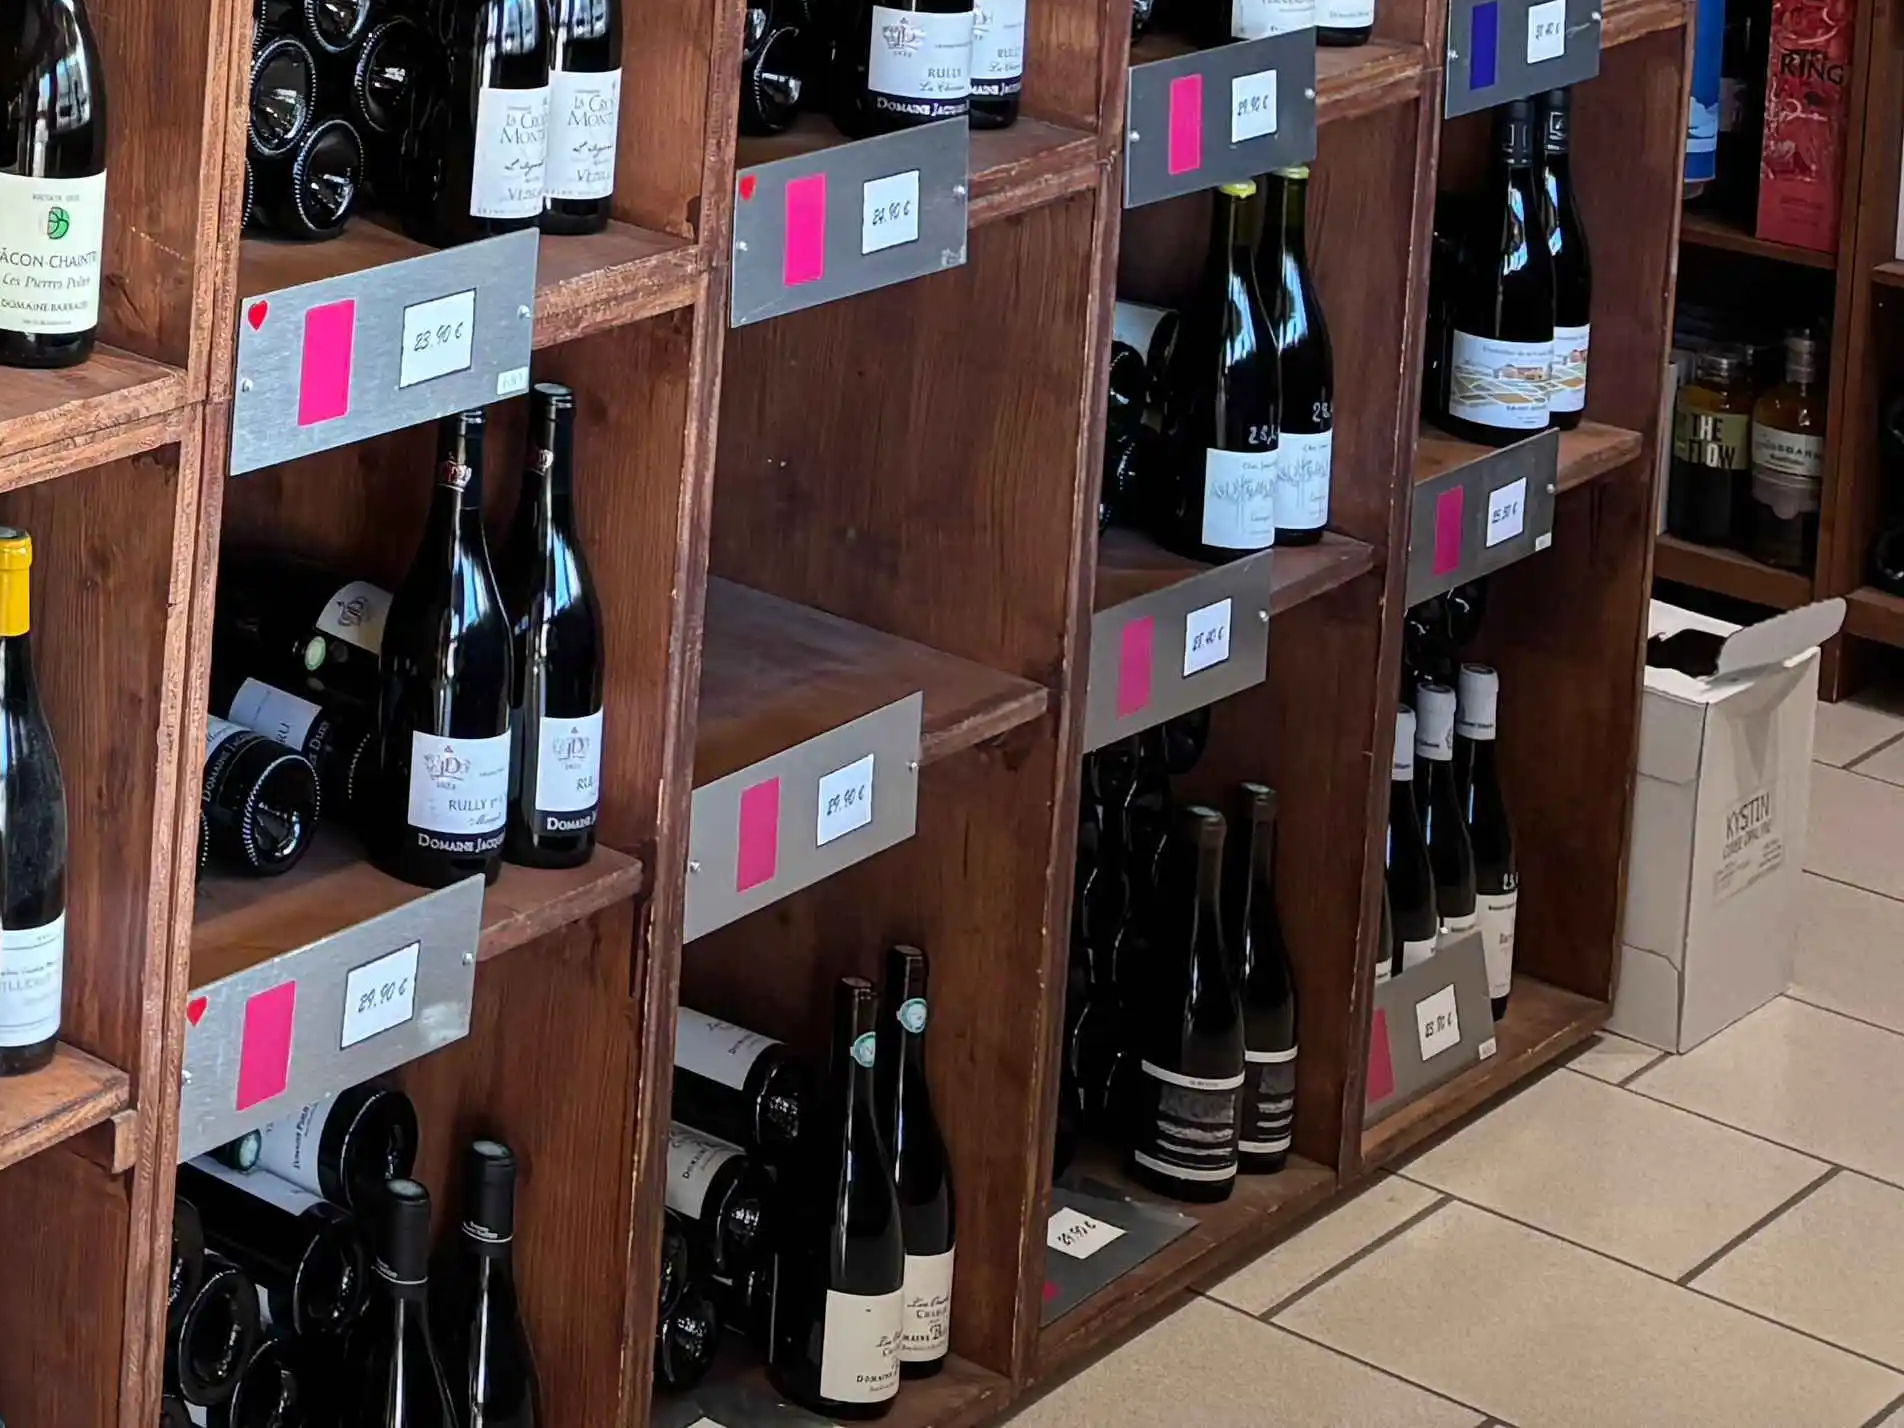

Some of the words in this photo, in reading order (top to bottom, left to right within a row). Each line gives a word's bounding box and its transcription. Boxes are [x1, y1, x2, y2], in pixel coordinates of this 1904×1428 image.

[1781, 52, 1843, 84] RING
[449, 798, 487, 812] RULLY
[418, 833, 474, 852] DOMAINE
